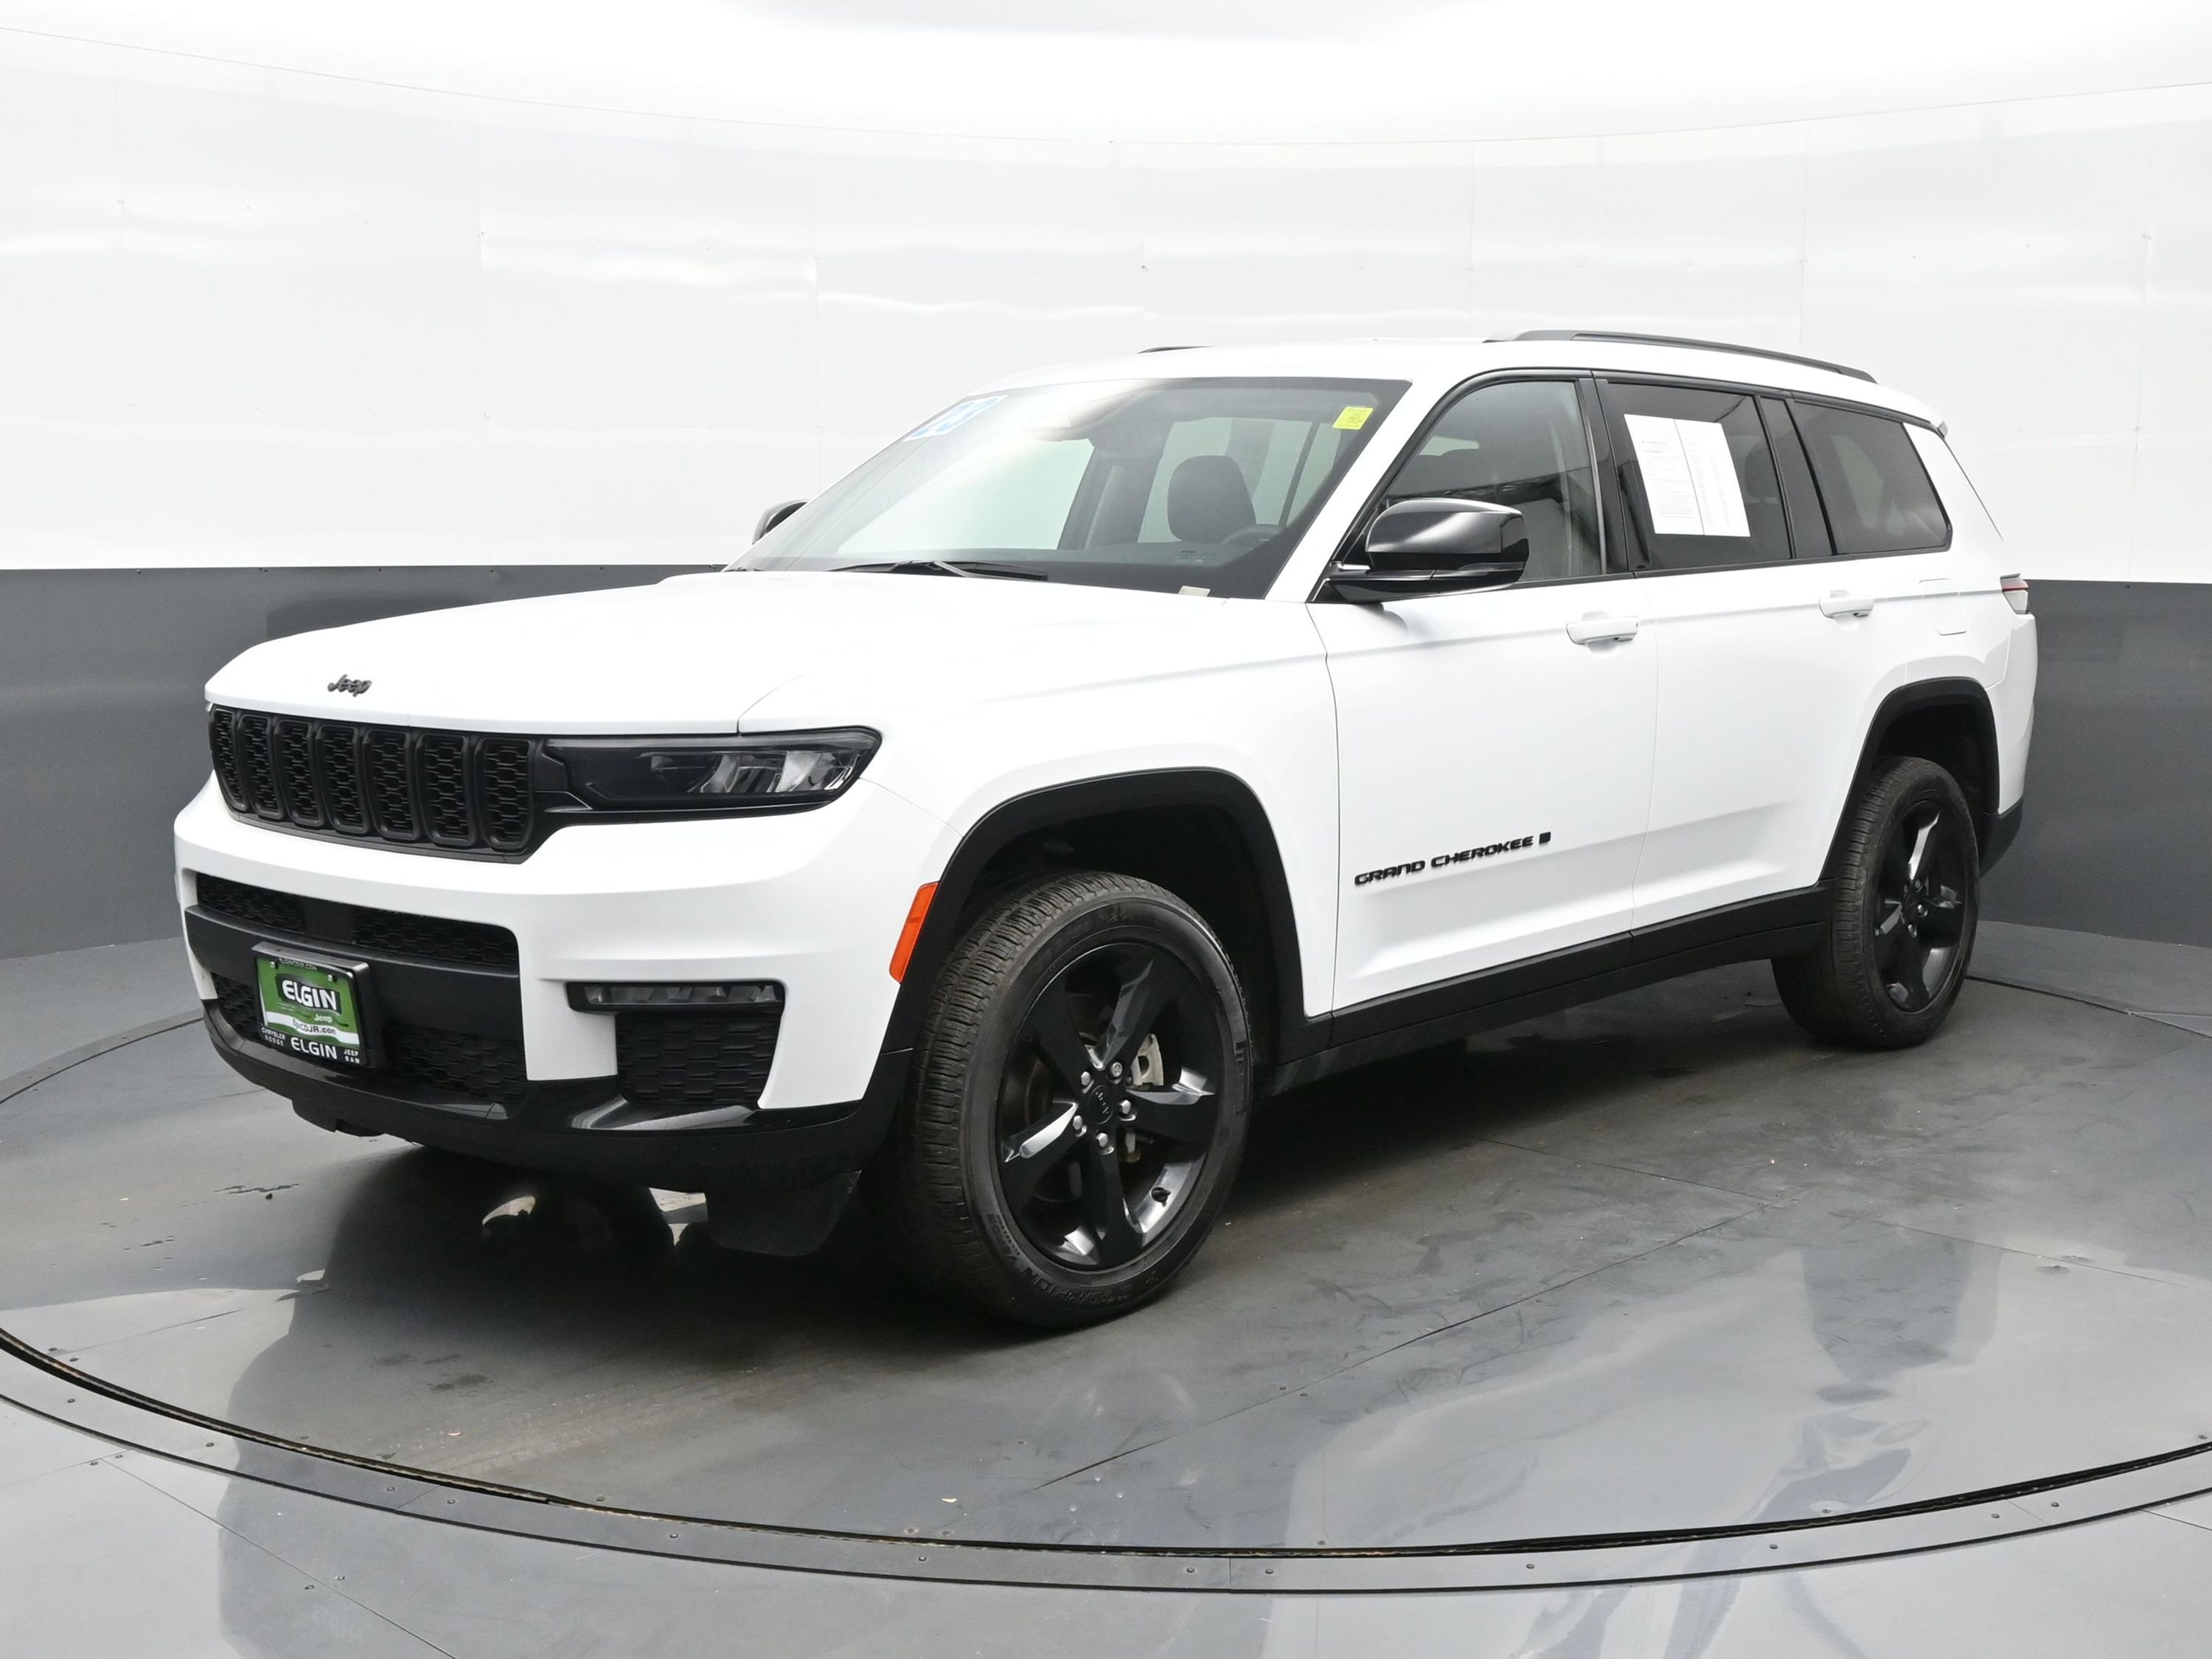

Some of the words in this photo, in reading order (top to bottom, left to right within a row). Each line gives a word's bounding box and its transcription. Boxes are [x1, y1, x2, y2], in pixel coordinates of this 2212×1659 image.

[327, 674, 372, 698] Jeep
[1354, 860, 1425, 886] GRAND
[1430, 835, 1534, 868] CHEROKEE
[282, 980, 338, 1011] ELGIN
[314, 1013, 333, 1023] Jeep
[261, 1026, 285, 1040] CHRYSLER
[291, 1037, 338, 1060] ELGIN
[344, 1048, 359, 1057] JEEP
[265, 1034, 284, 1046] DODGE
[344, 1055, 361, 1064] RAM
